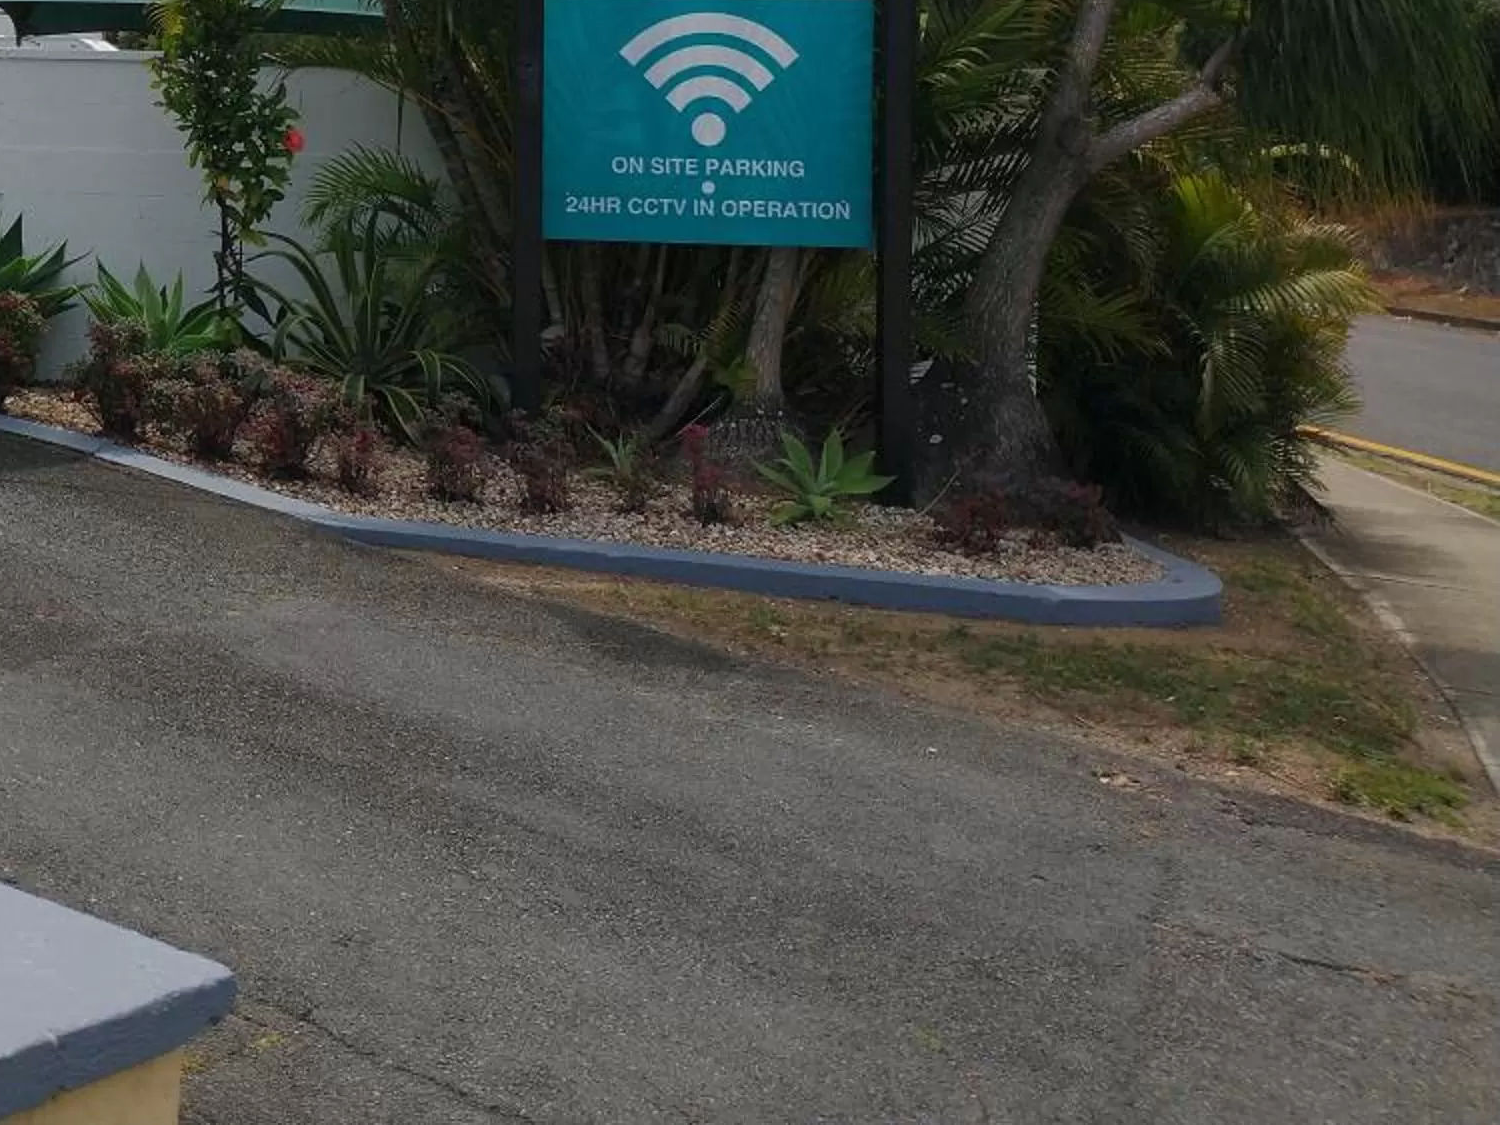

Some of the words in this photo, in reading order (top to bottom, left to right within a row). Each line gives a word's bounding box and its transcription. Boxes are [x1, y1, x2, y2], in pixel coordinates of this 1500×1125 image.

[611, 156, 644, 175] ON
[650, 158, 699, 176] SITE
[704, 158, 805, 178] PARKING
[566, 196, 621, 215] 24HR
[627, 197, 687, 216] CCTV
[693, 199, 715, 217] IN
[720, 199, 852, 220] OPERATION
